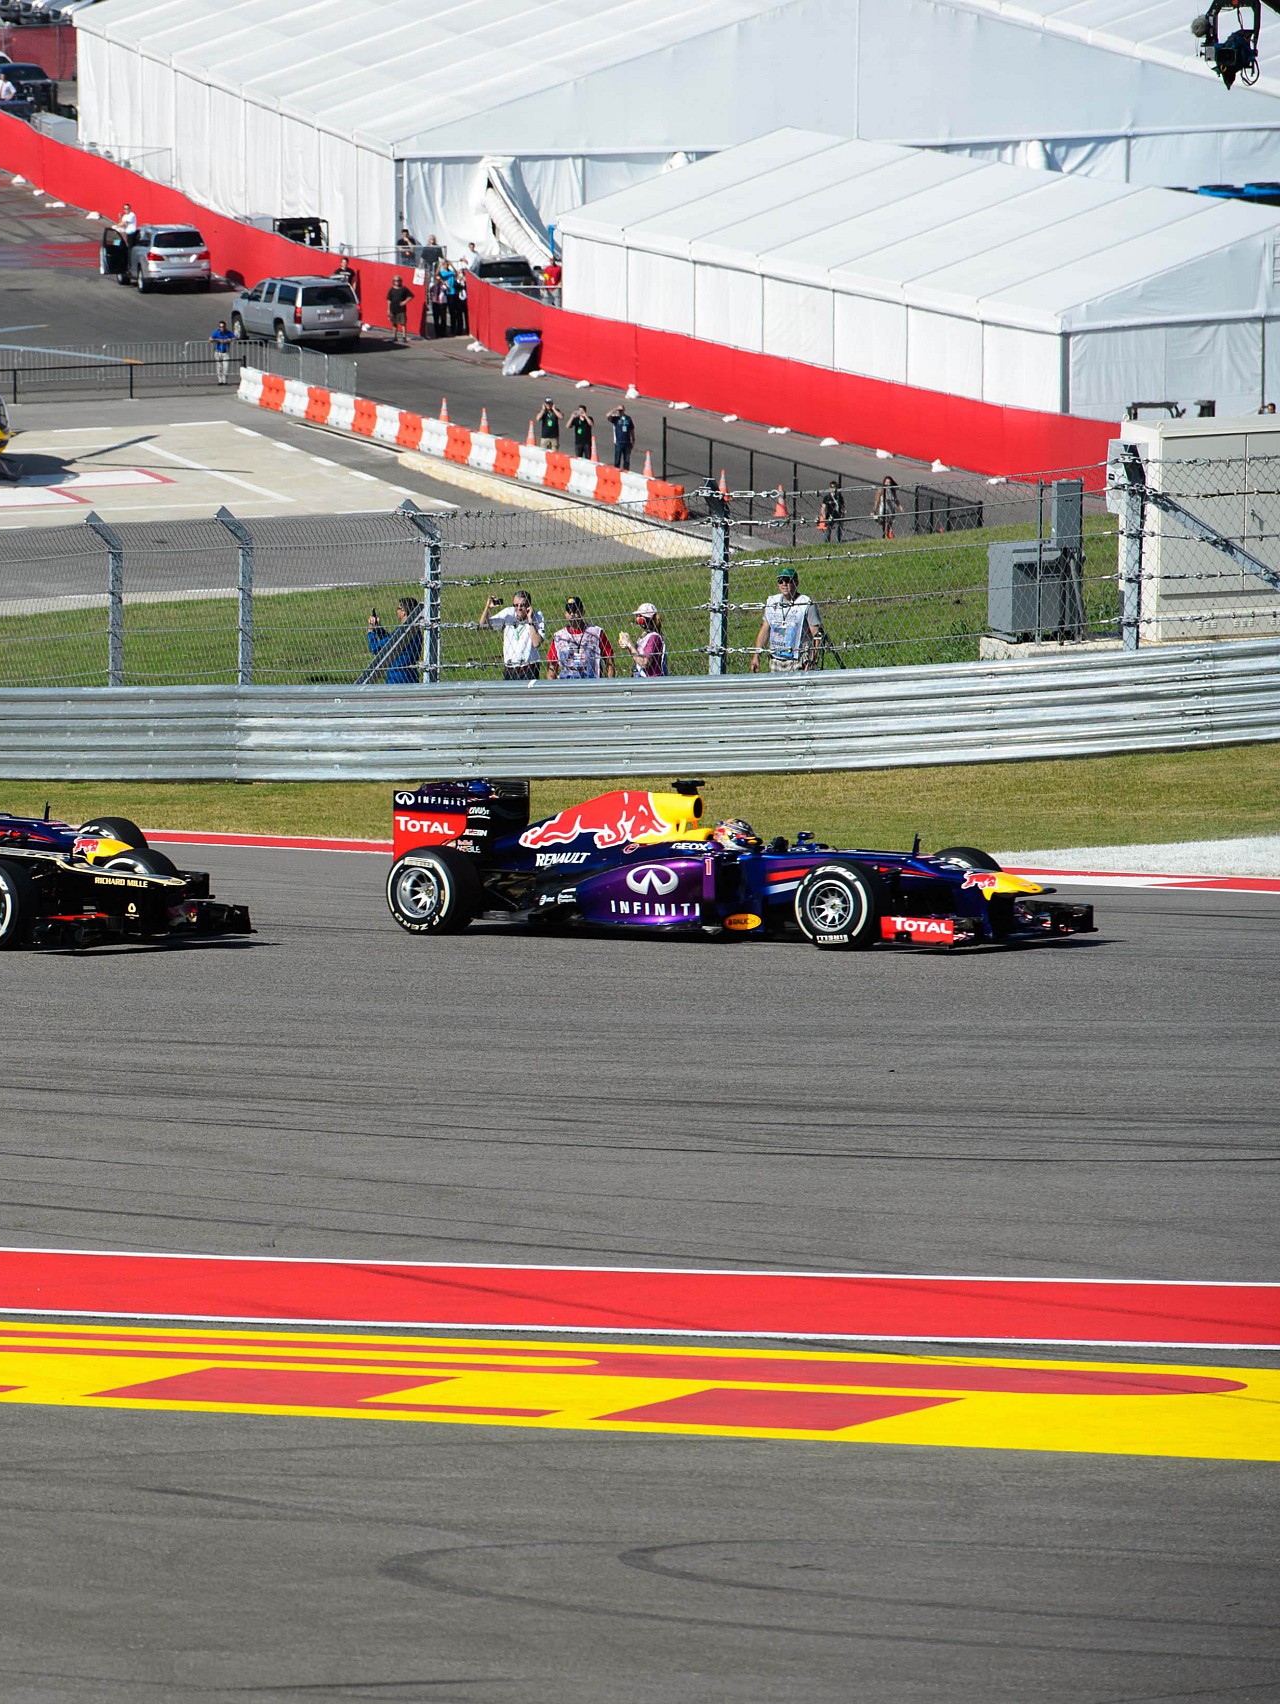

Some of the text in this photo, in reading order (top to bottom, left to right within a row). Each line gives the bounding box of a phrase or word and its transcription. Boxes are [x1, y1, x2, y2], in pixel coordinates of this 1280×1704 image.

[395, 816, 455, 835] TOTAL
[671, 841, 707, 851] GEOX
[535, 852, 591, 867] RENAULT
[704, 858, 712, 876] 1
[95, 876, 149, 889] RICHARD MILLE
[610, 900, 701, 917] INFINITI
[891, 916, 952, 935] TOTAL
